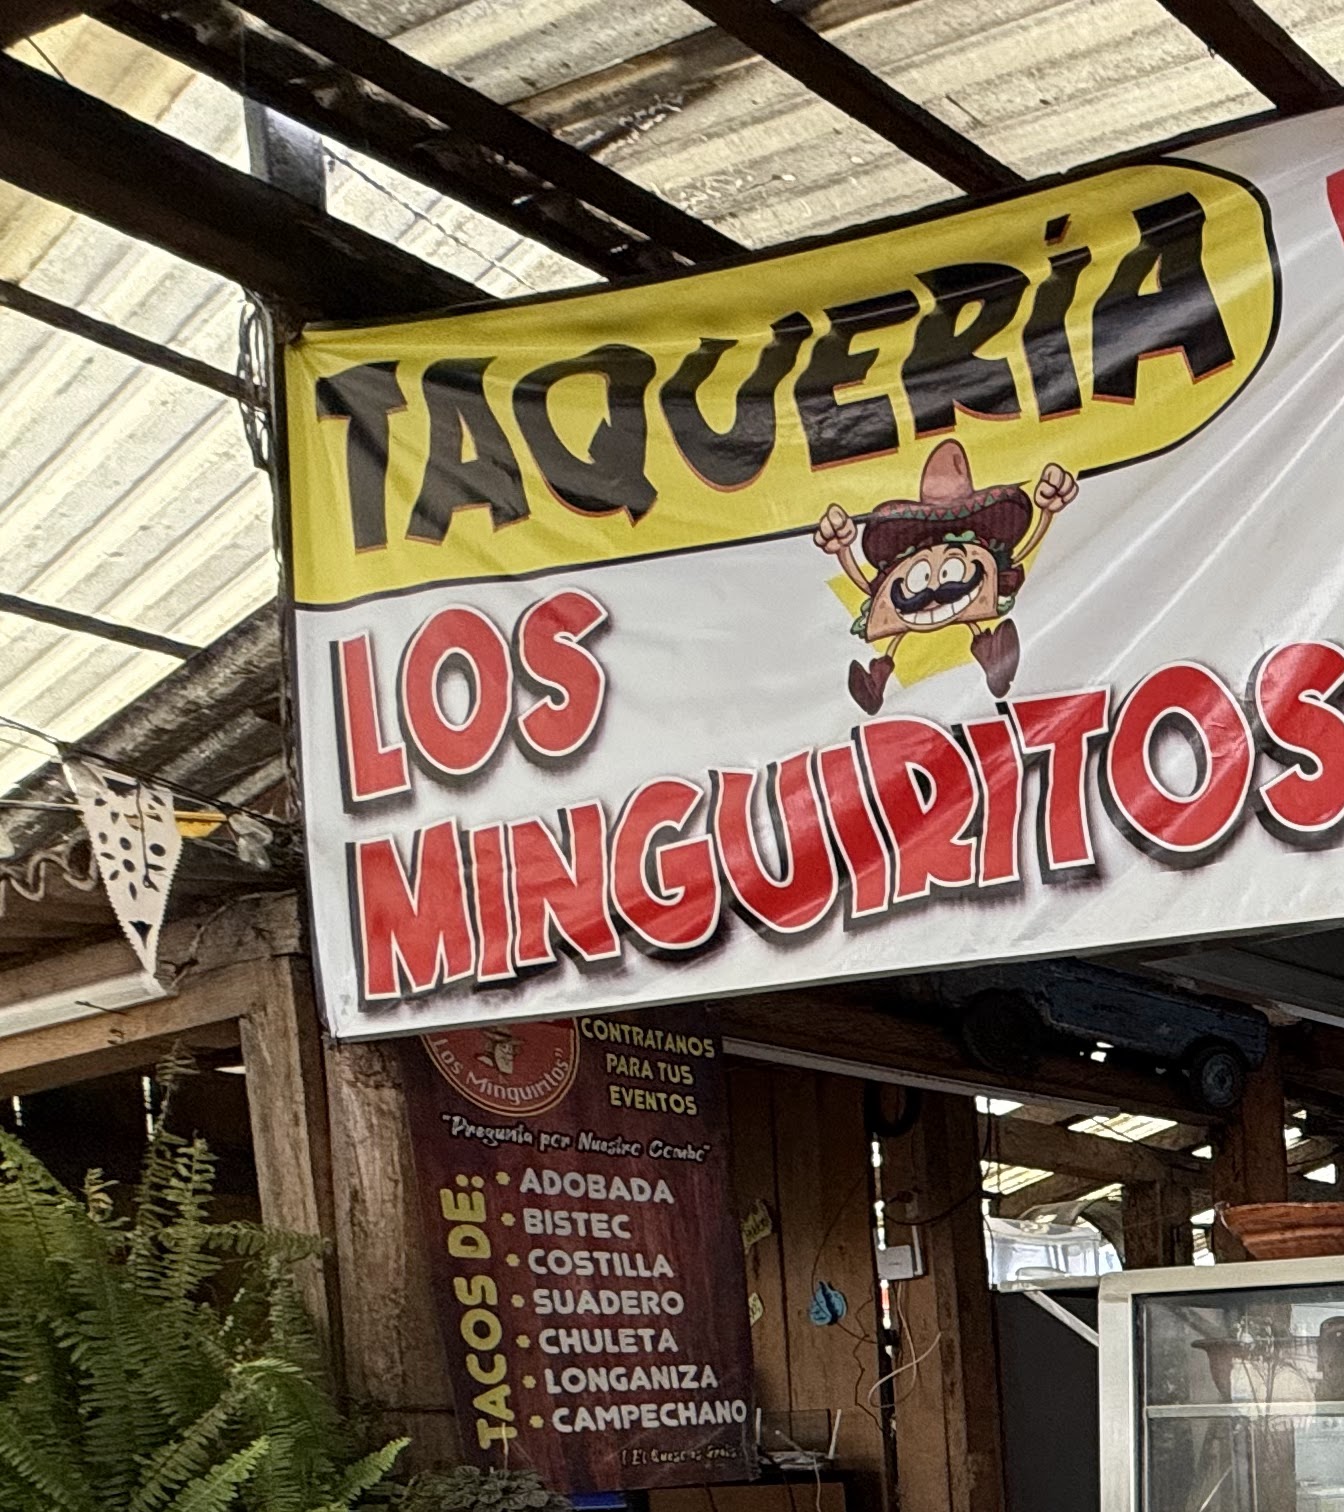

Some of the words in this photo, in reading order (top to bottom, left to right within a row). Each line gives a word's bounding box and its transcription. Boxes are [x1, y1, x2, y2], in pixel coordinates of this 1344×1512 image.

[336, 590, 608, 803] LOS
[581, 1017, 716, 1059] CONTRATANOS
[432, 1038, 464, 1075] Los
[606, 1053, 654, 1080] PARA
[657, 1061, 694, 1085] TUS
[609, 1085, 698, 1116] EVENTOS
[519, 1168, 676, 1206] ADOBADA
[440, 1174, 491, 1259] DE:
[523, 1207, 633, 1240] BISTEC
[528, 1249, 675, 1279] COSTILLA
[533, 1289, 685, 1317] SUADERO
[538, 1327, 679, 1355] CHULETA
[453, 1274, 519, 1450] TACOS
[544, 1366, 719, 1396] LONGANIZA
[551, 1399, 748, 1434] CAMPECHANO
